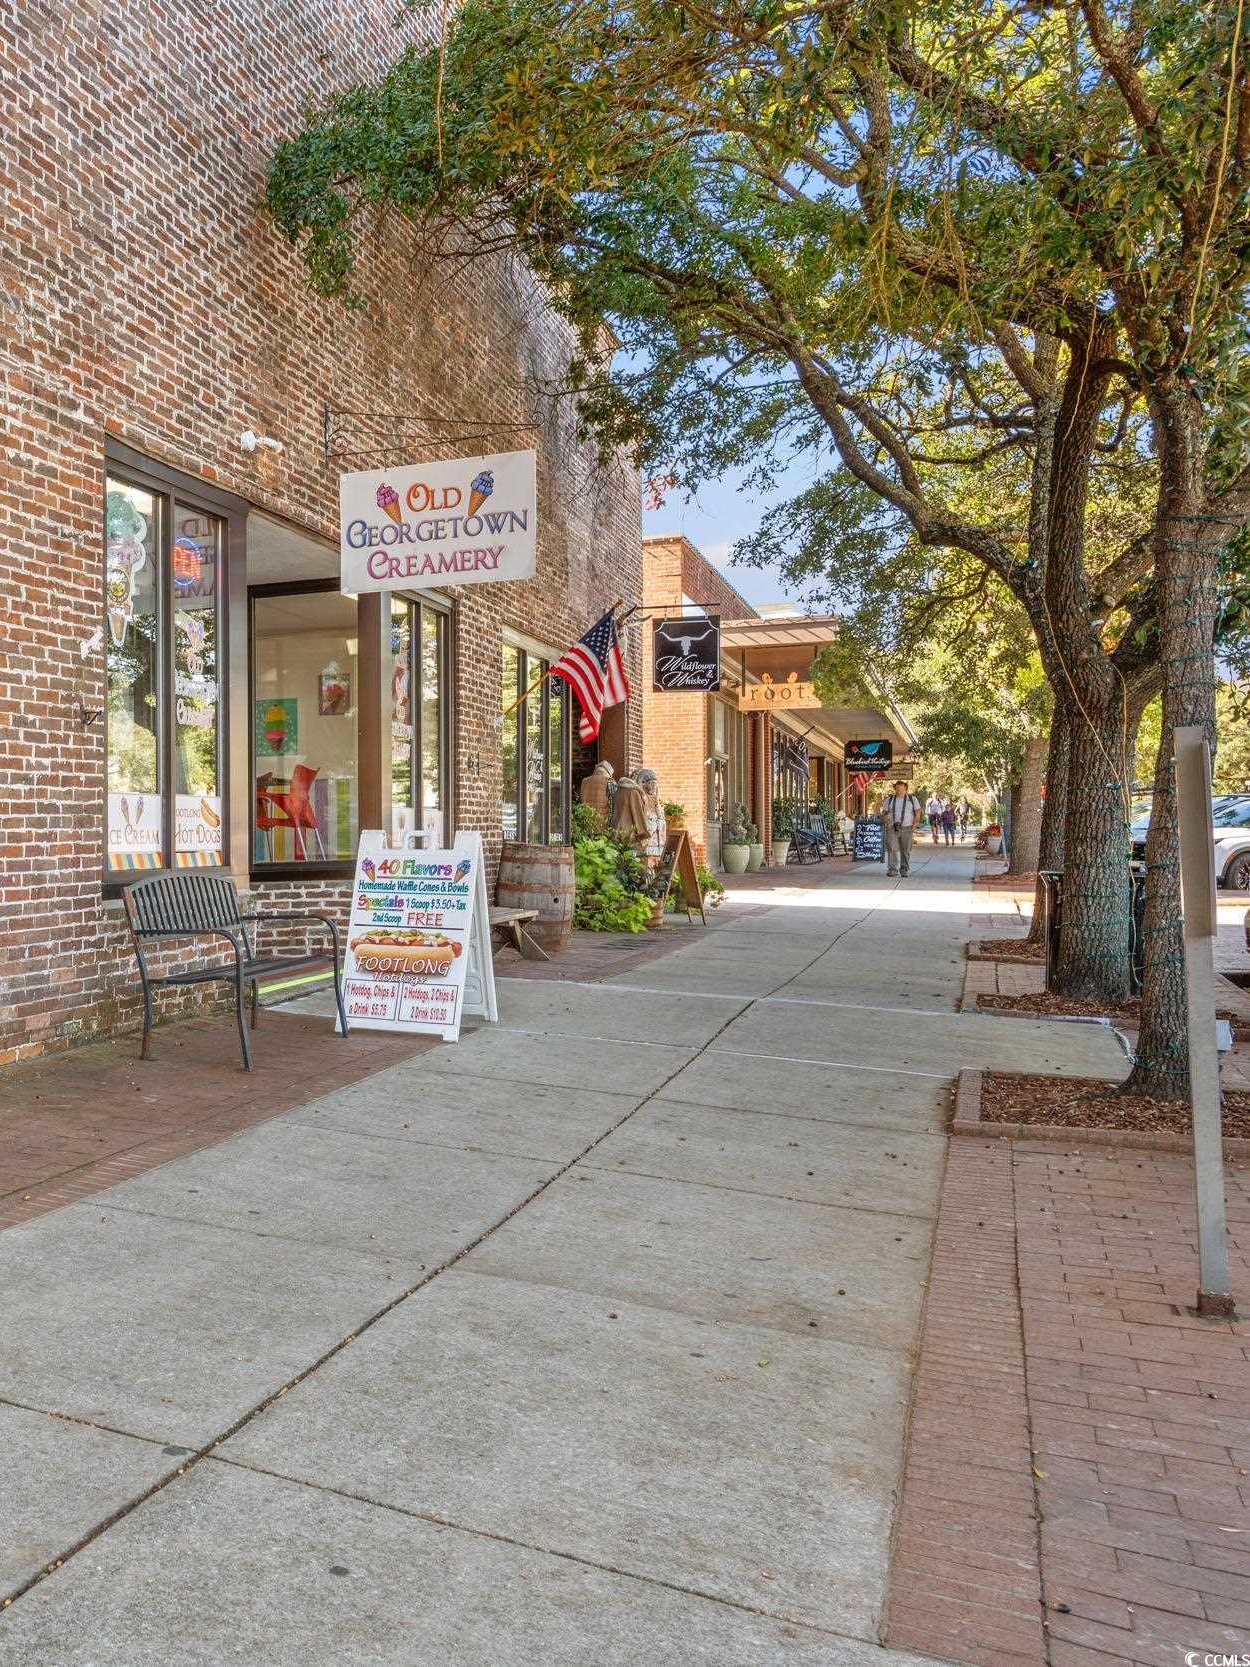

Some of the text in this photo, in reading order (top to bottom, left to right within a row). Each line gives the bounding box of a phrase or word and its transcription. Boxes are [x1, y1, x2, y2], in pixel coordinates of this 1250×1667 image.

[405, 482, 463, 513] OLD
[345, 509, 529, 549] GEORGETOWN
[366, 545, 506, 580] CREAMERY
[655, 654, 717, 672] Wildflower
[661, 669, 711, 687] Whiskey
[706, 669, 714, 679] &
[378, 858, 453, 876] 40 Flavors
[358, 880, 469, 893] Homemade Waffle Cones & Bowls
[357, 894, 405, 910] Specials
[410, 898, 431, 912] Scoop
[372, 912, 444, 927] 2nd Scoop FREE
[356, 956, 451, 977] FOOTLONG
